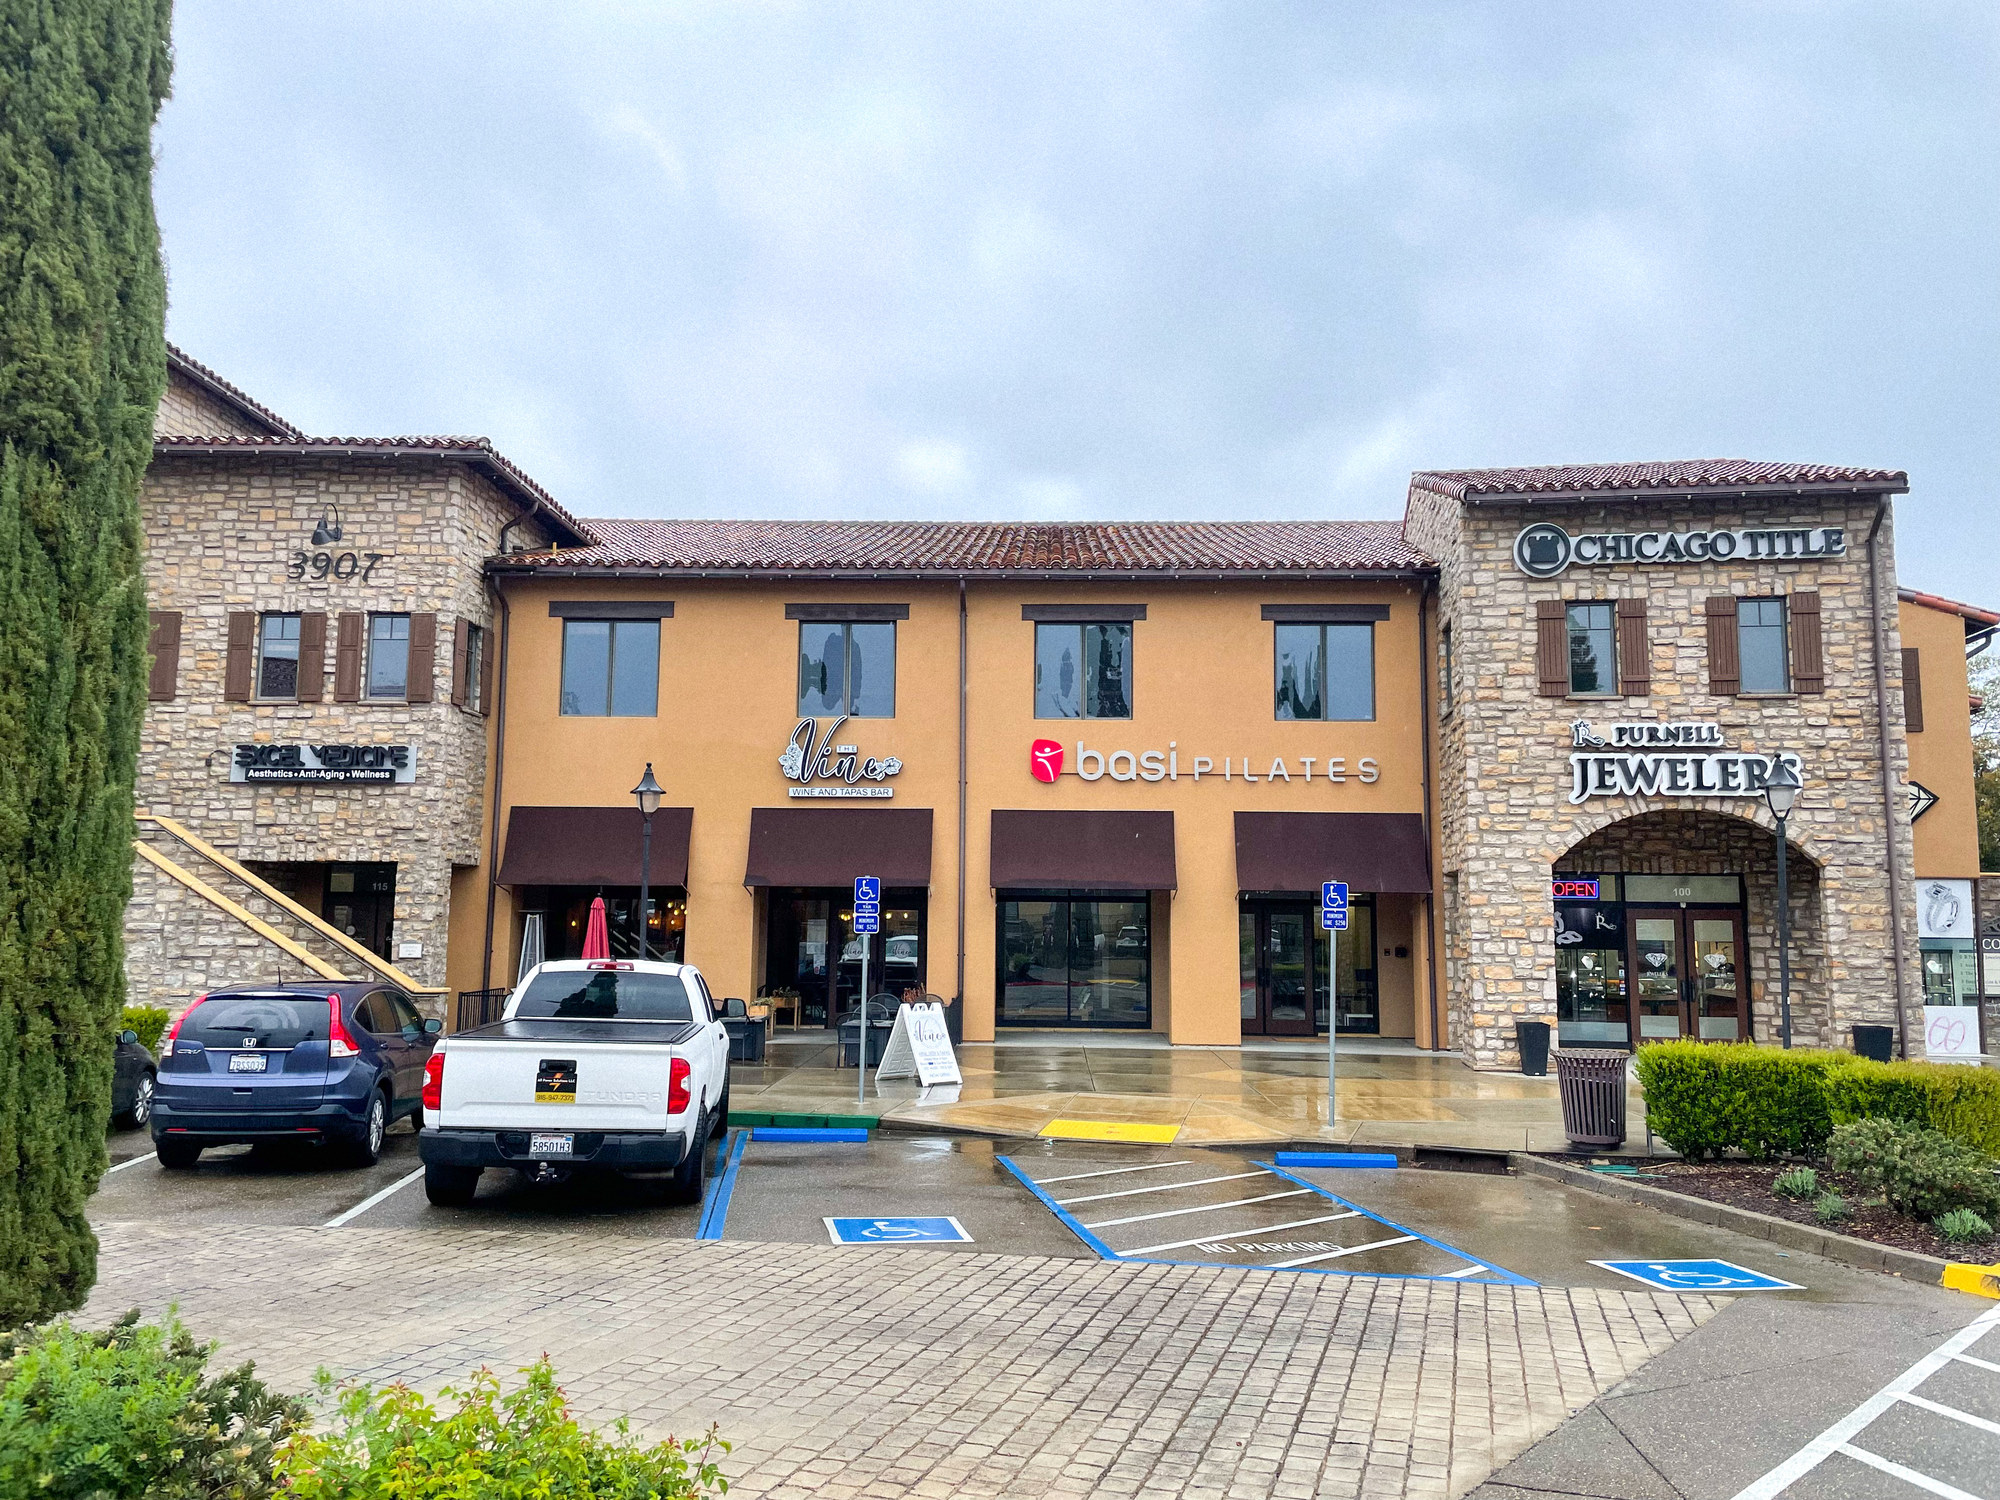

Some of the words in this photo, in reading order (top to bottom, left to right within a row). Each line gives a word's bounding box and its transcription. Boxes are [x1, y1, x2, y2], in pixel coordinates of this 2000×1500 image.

[1573, 531, 1737, 562] CHICAGO
[1742, 527, 1847, 557] TITLE
[287, 552, 383, 582] 3907
[1615, 726, 1721, 744] PURNELL
[235, 745, 305, 767] EXCEL
[310, 745, 409, 767] MEDICINE
[790, 715, 880, 784] Vine
[1076, 741, 1178, 782] basi
[1194, 757, 1381, 784] PILATES
[248, 769, 293, 778] Aesthetics
[299, 769, 345, 780] Anti-Aging
[351, 770, 390, 778] Wellness
[792, 788, 816, 796] WINE
[818, 788, 838, 796] AND
[840, 788, 868, 796] TAPAS
[871, 788, 890, 796] BAR
[372, 882, 388, 891] 115
[1552, 882, 1596, 897] OPEN
[1673, 887, 1691, 897] 100
[583, 1090, 661, 1102] TUNDRA
[532, 1141, 571, 1152] 58501H3
[1195, 1243, 1237, 1254] NO
[1235, 1241, 1344, 1253] PARKING
